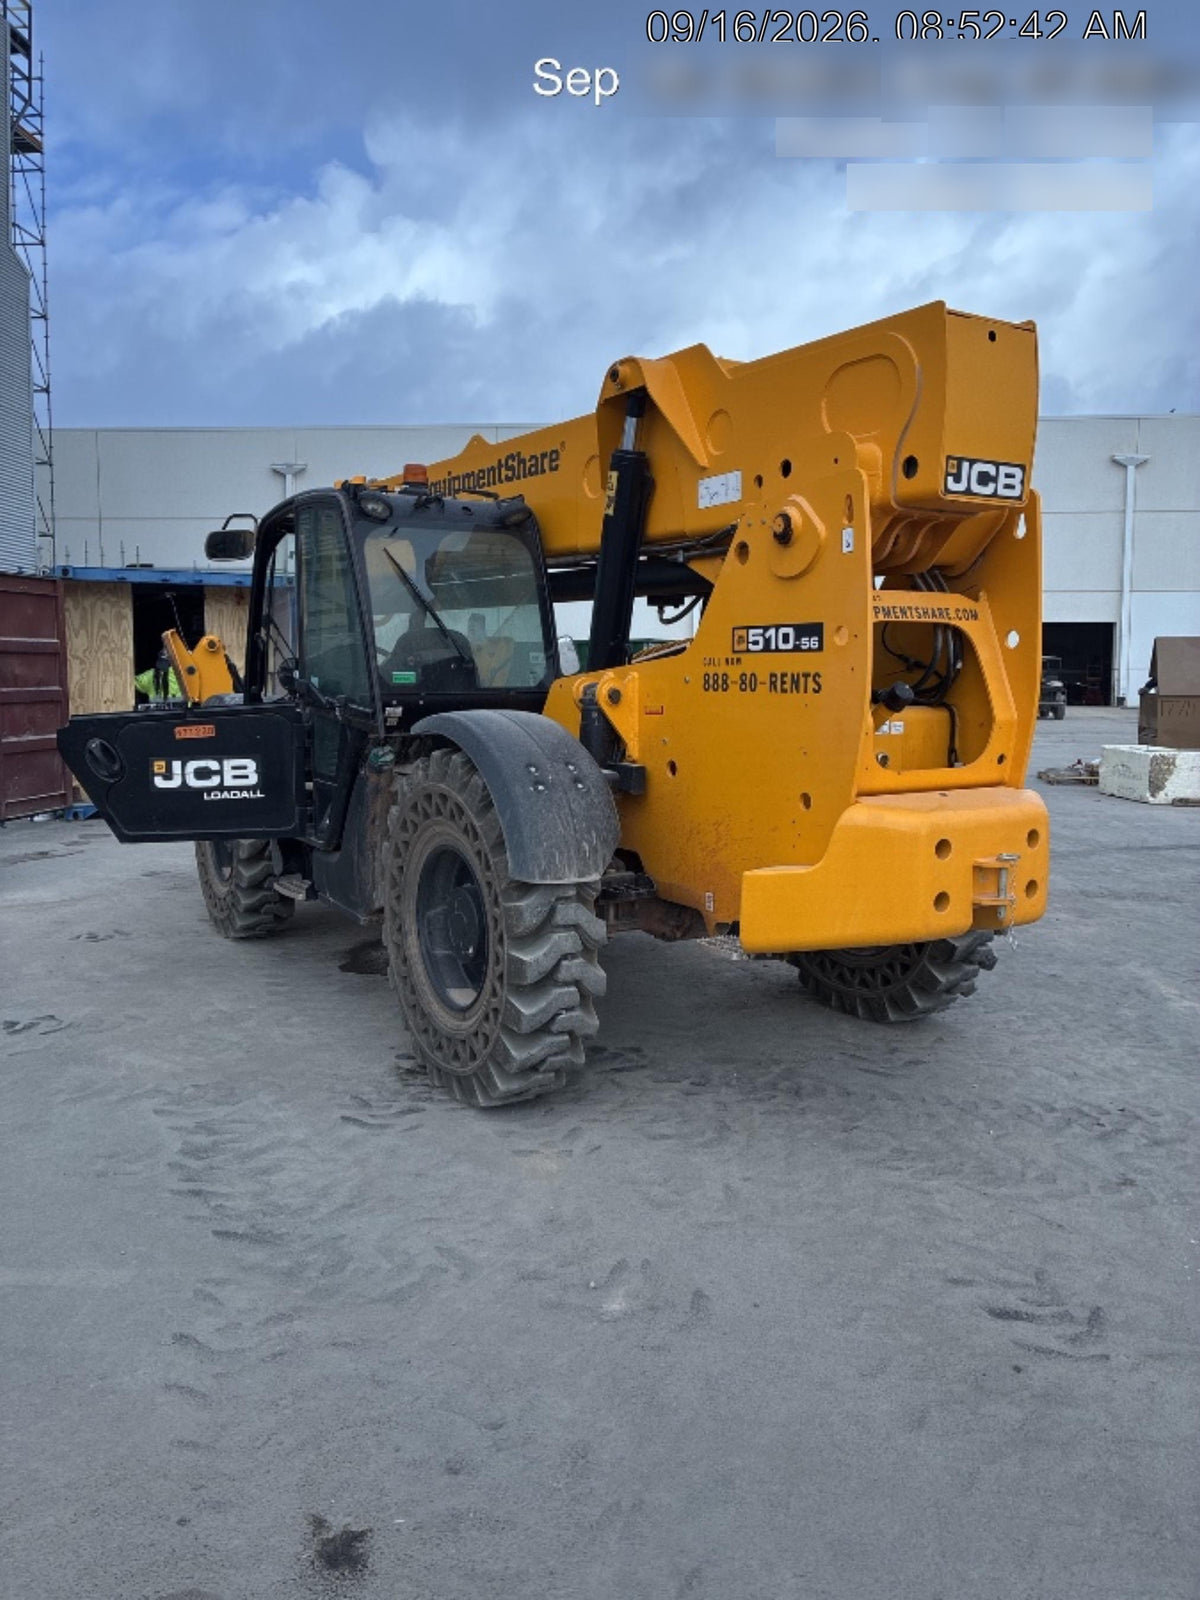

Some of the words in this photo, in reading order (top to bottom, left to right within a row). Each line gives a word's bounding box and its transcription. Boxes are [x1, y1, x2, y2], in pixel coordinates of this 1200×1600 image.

[427, 448, 560, 500] quipmentShare
[946, 459, 1024, 498] JCB
[703, 671, 822, 694] 888-80-RENTS
[153, 759, 259, 789] JCB
[203, 789, 265, 801] LOADALL
